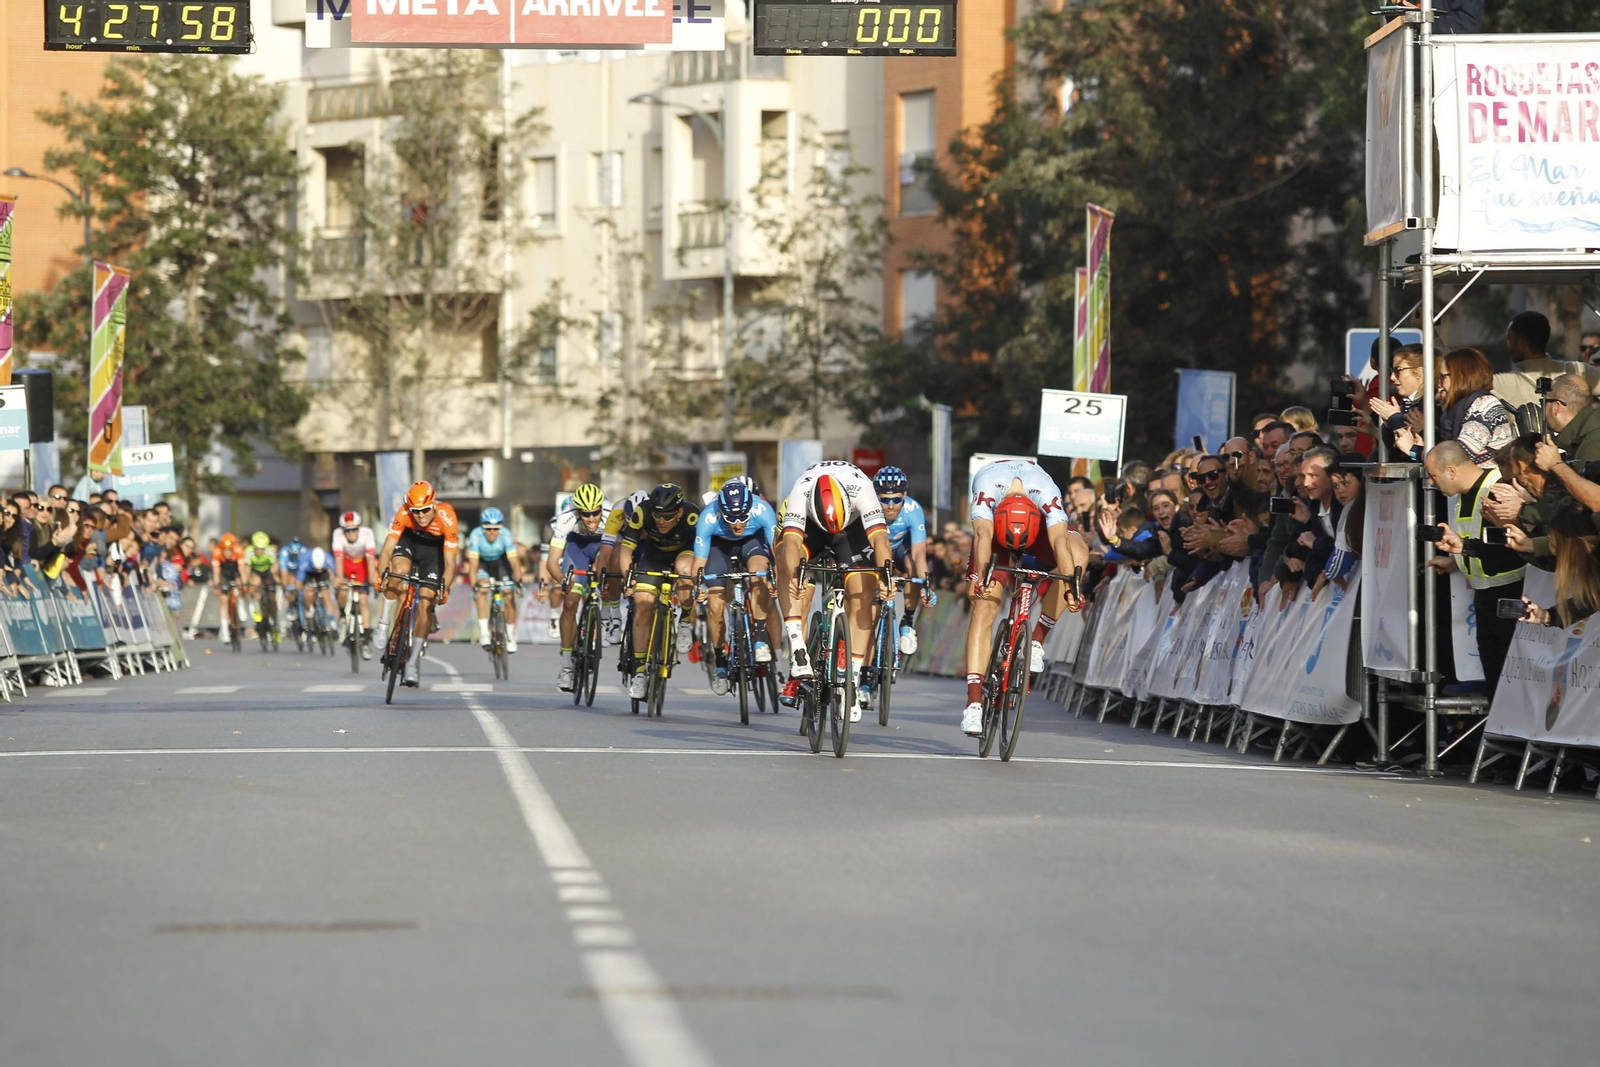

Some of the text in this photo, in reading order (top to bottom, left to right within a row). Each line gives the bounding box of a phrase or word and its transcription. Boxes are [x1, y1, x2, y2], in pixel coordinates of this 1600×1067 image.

[103, 4, 160, 39] 27
[181, 5, 236, 41] 58
[366, 0, 500, 15] META
[1466, 62, 1600, 97] ROQUETAS
[1468, 100, 1600, 144] DE MAR
[1469, 151, 1587, 184] El Mar
[1469, 187, 1523, 225] que
[1063, 397, 1102, 416] 25
[1063, 429, 1113, 444] cajamar
[132, 451, 154, 463] 50
